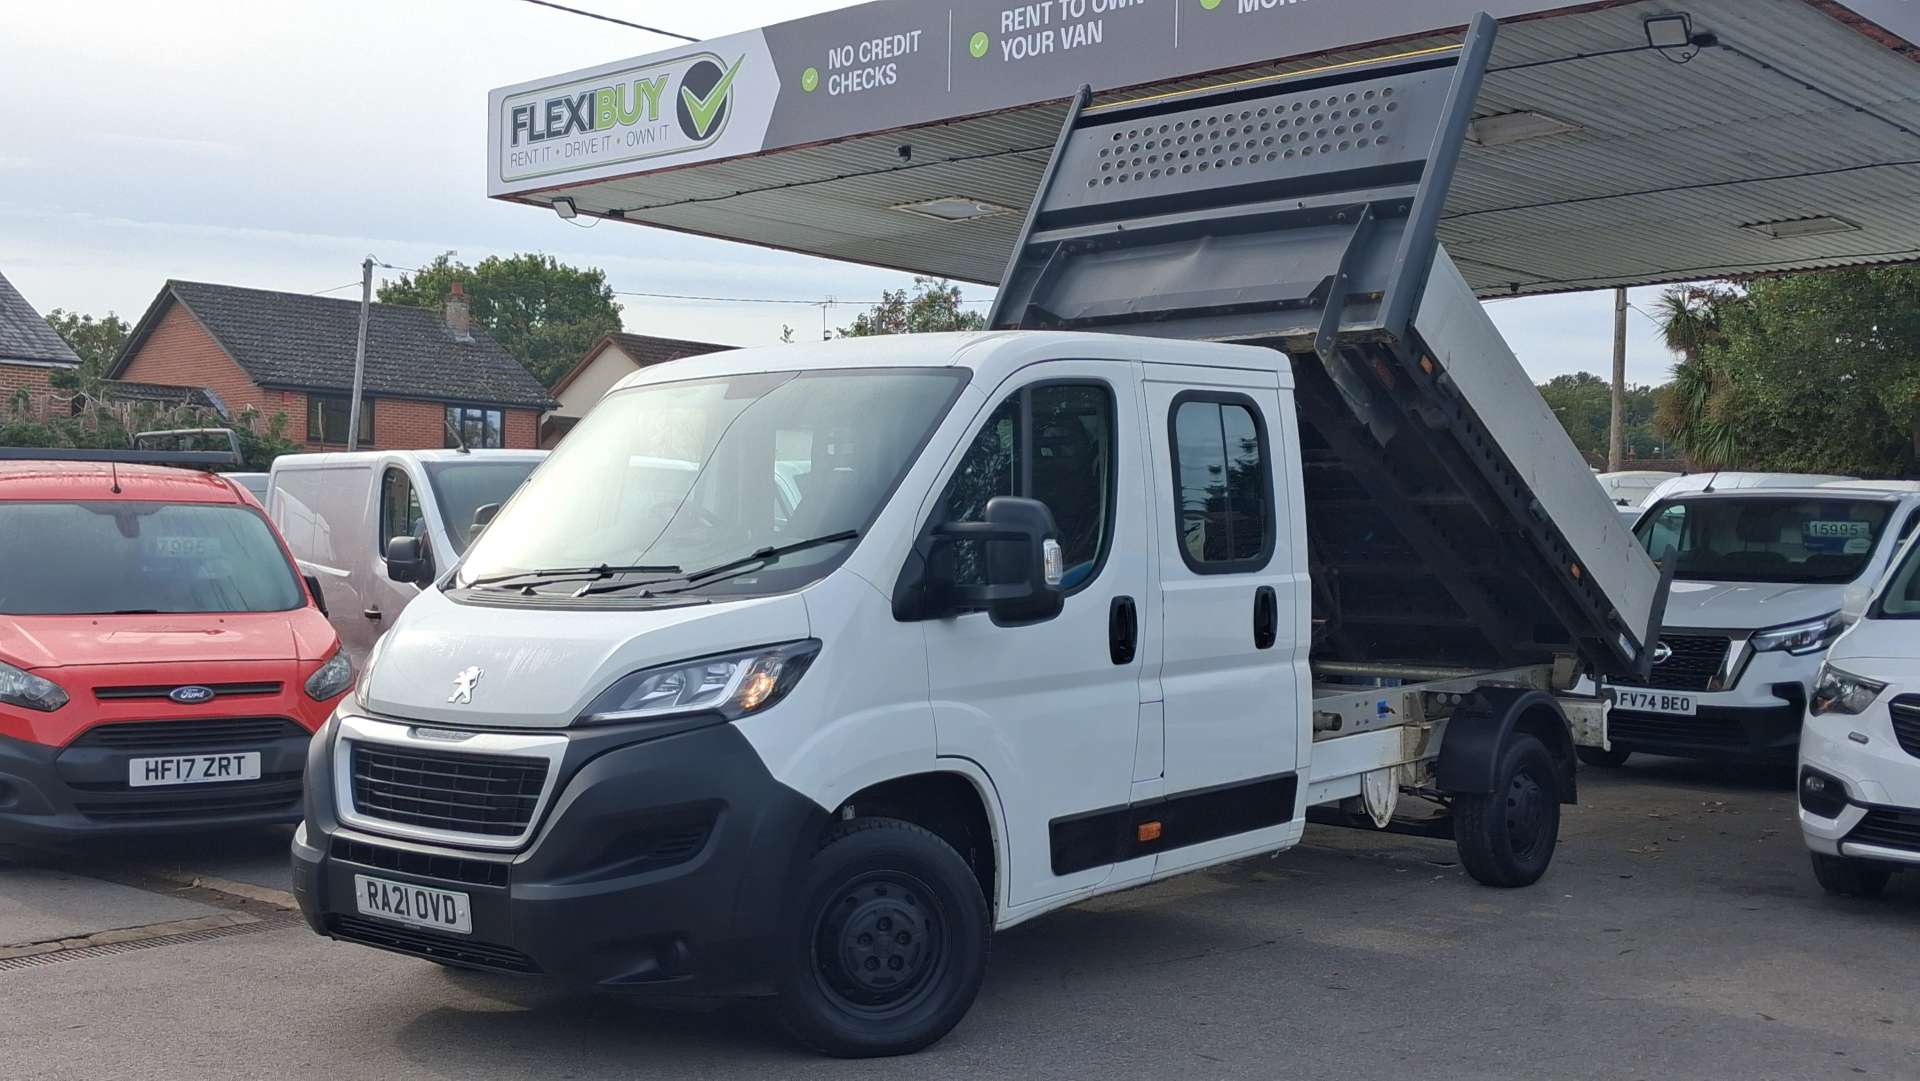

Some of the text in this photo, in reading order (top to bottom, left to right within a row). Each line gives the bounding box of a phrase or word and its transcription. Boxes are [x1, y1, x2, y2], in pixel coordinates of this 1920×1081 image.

[1001, 1, 1053, 34] RENT
[1059, 0, 1086, 20] TO
[828, 30, 922, 70] NO CREDIT
[1000, 19, 1103, 61] YOUR VAN
[828, 63, 897, 95] CHECKS
[511, 73, 670, 148] FLEXIBUY
[510, 124, 670, 168] RENT IT DRIVE IT OWN IT
[180, 688, 205, 699] Ford
[1620, 692, 1690, 711] FV74 BEO
[145, 756, 246, 781] HF17 ZRT
[367, 880, 457, 925] RA21 OVD
